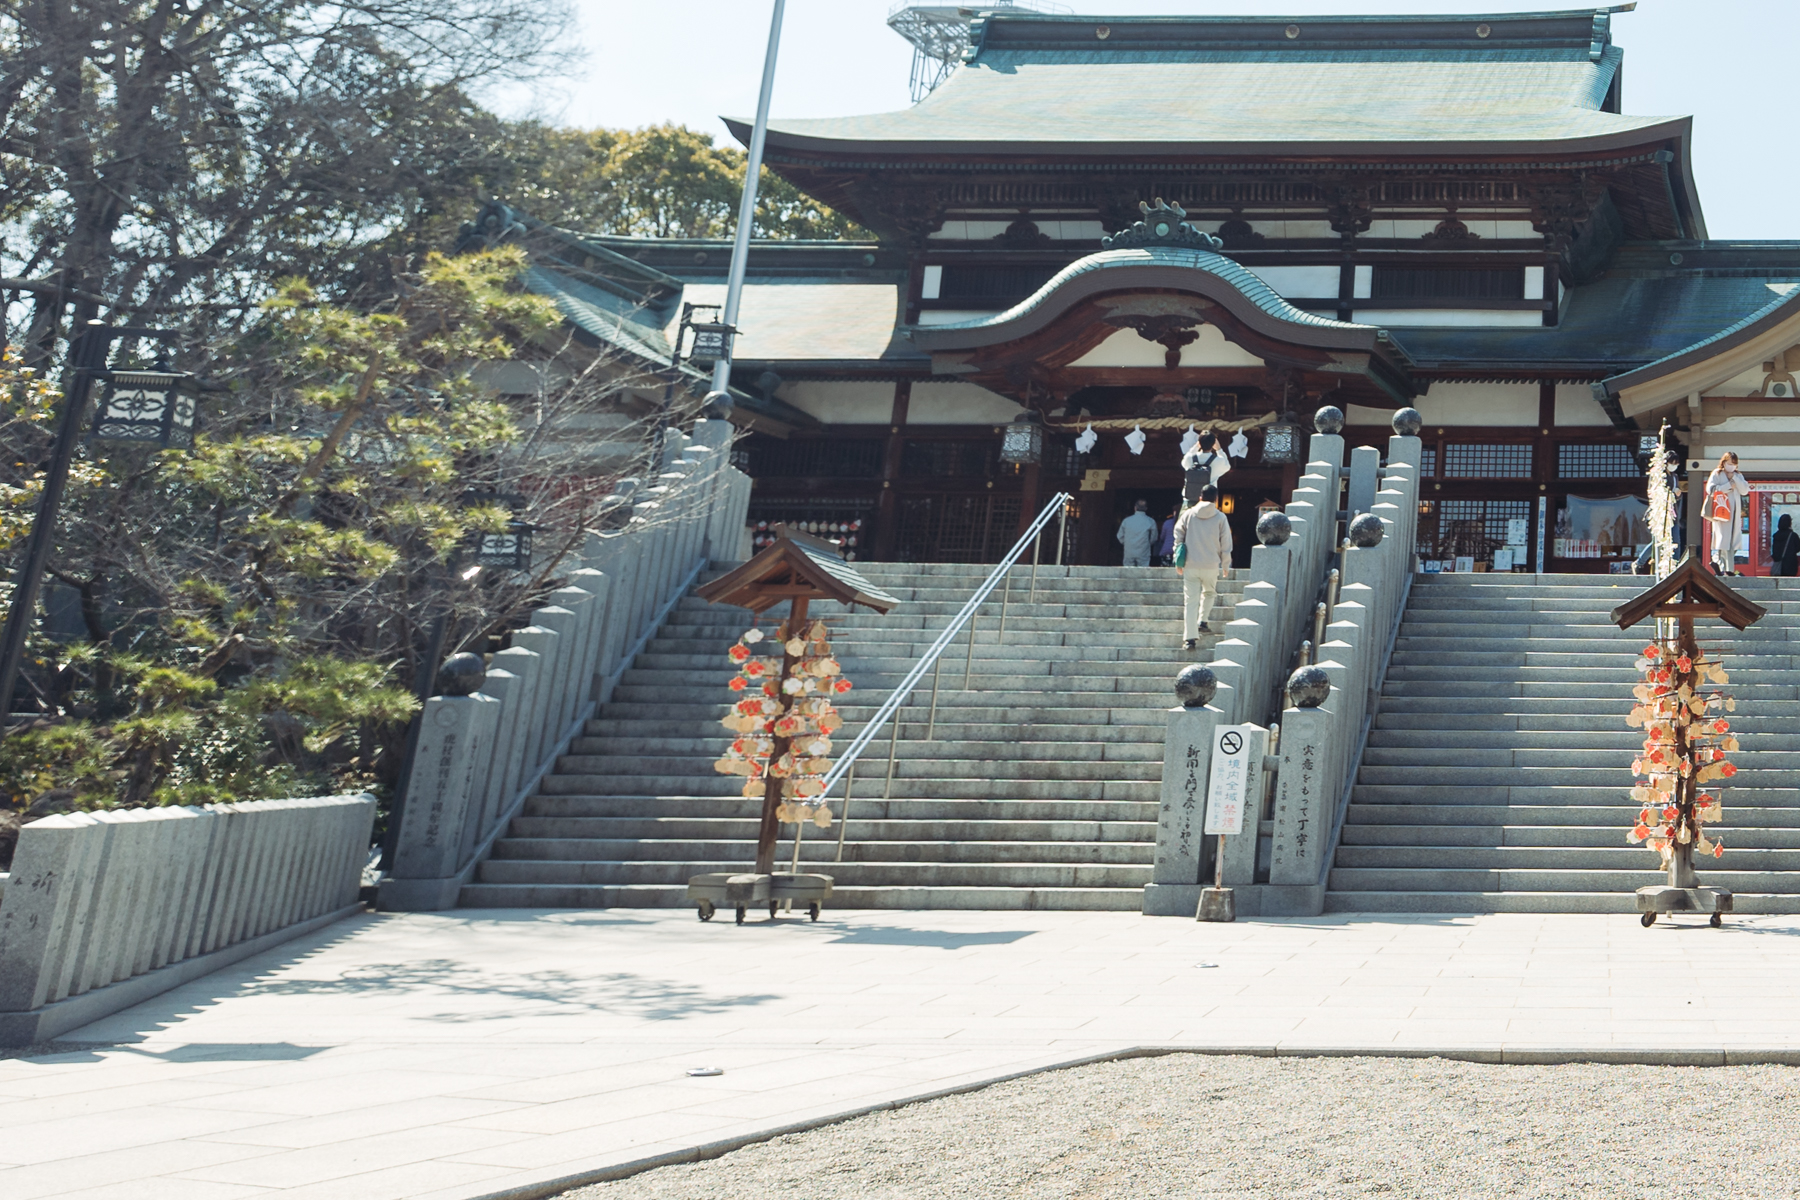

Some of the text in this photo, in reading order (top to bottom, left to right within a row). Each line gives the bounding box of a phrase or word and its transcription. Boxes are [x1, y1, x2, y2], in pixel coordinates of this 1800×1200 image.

[1222, 758, 1241, 829] 境内全域禁煙
